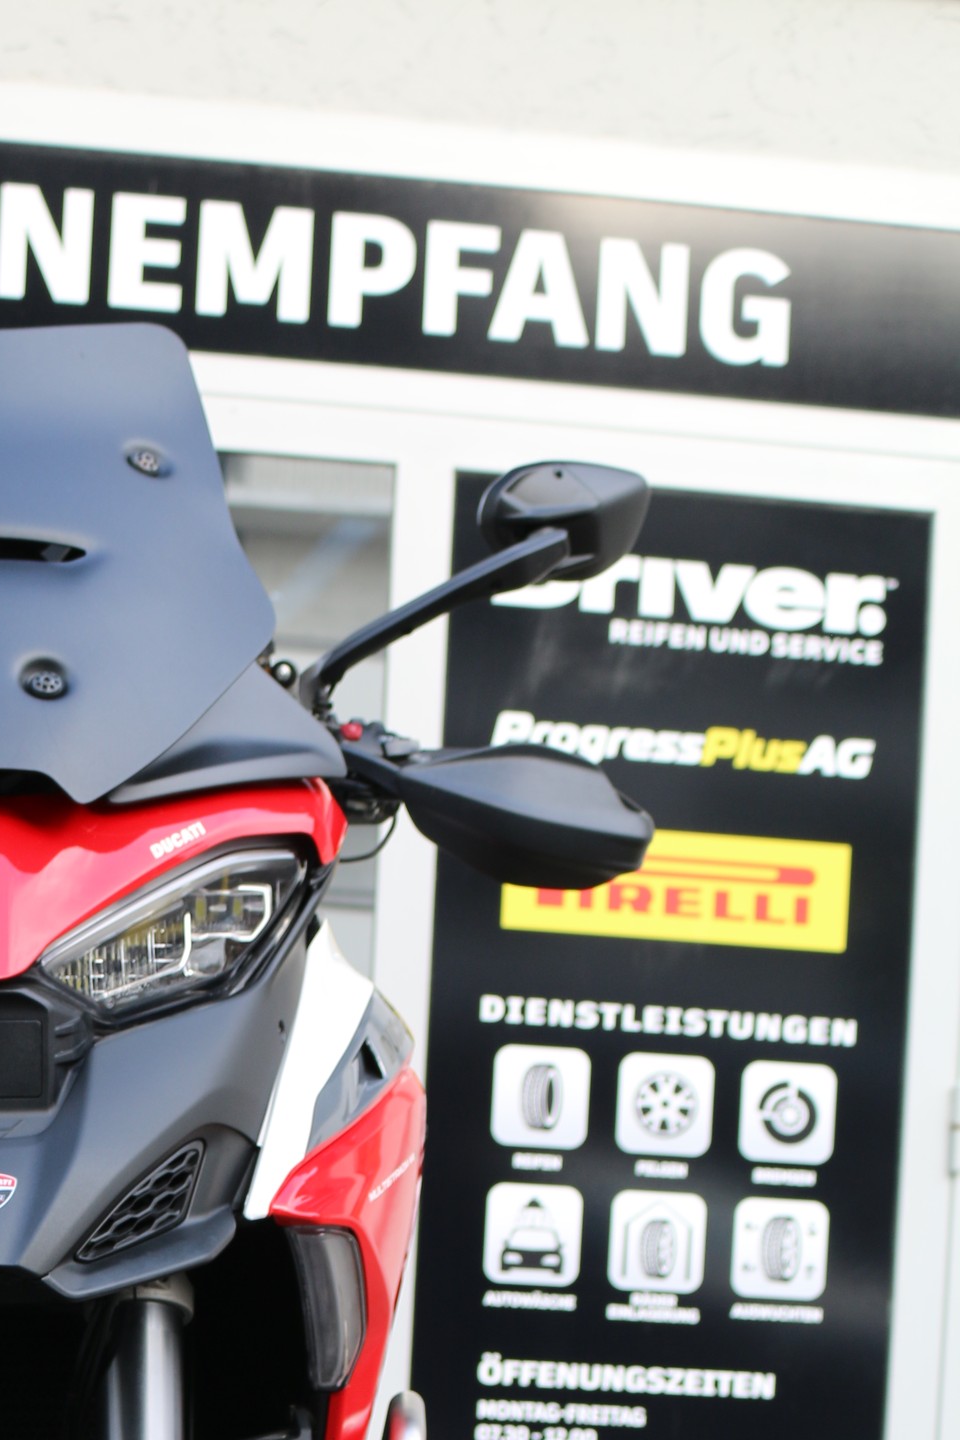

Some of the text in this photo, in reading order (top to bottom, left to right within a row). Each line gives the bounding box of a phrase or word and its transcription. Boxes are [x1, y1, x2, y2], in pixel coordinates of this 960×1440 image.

[609, 618, 883, 666] REIFEN UND SERVICE
[149, 821, 207, 860] DUCATI
[479, 994, 857, 1047] DIENSTLEISTUNGEN
[477, 1352, 776, 1399] ÖFFENUNGSZEITEN
